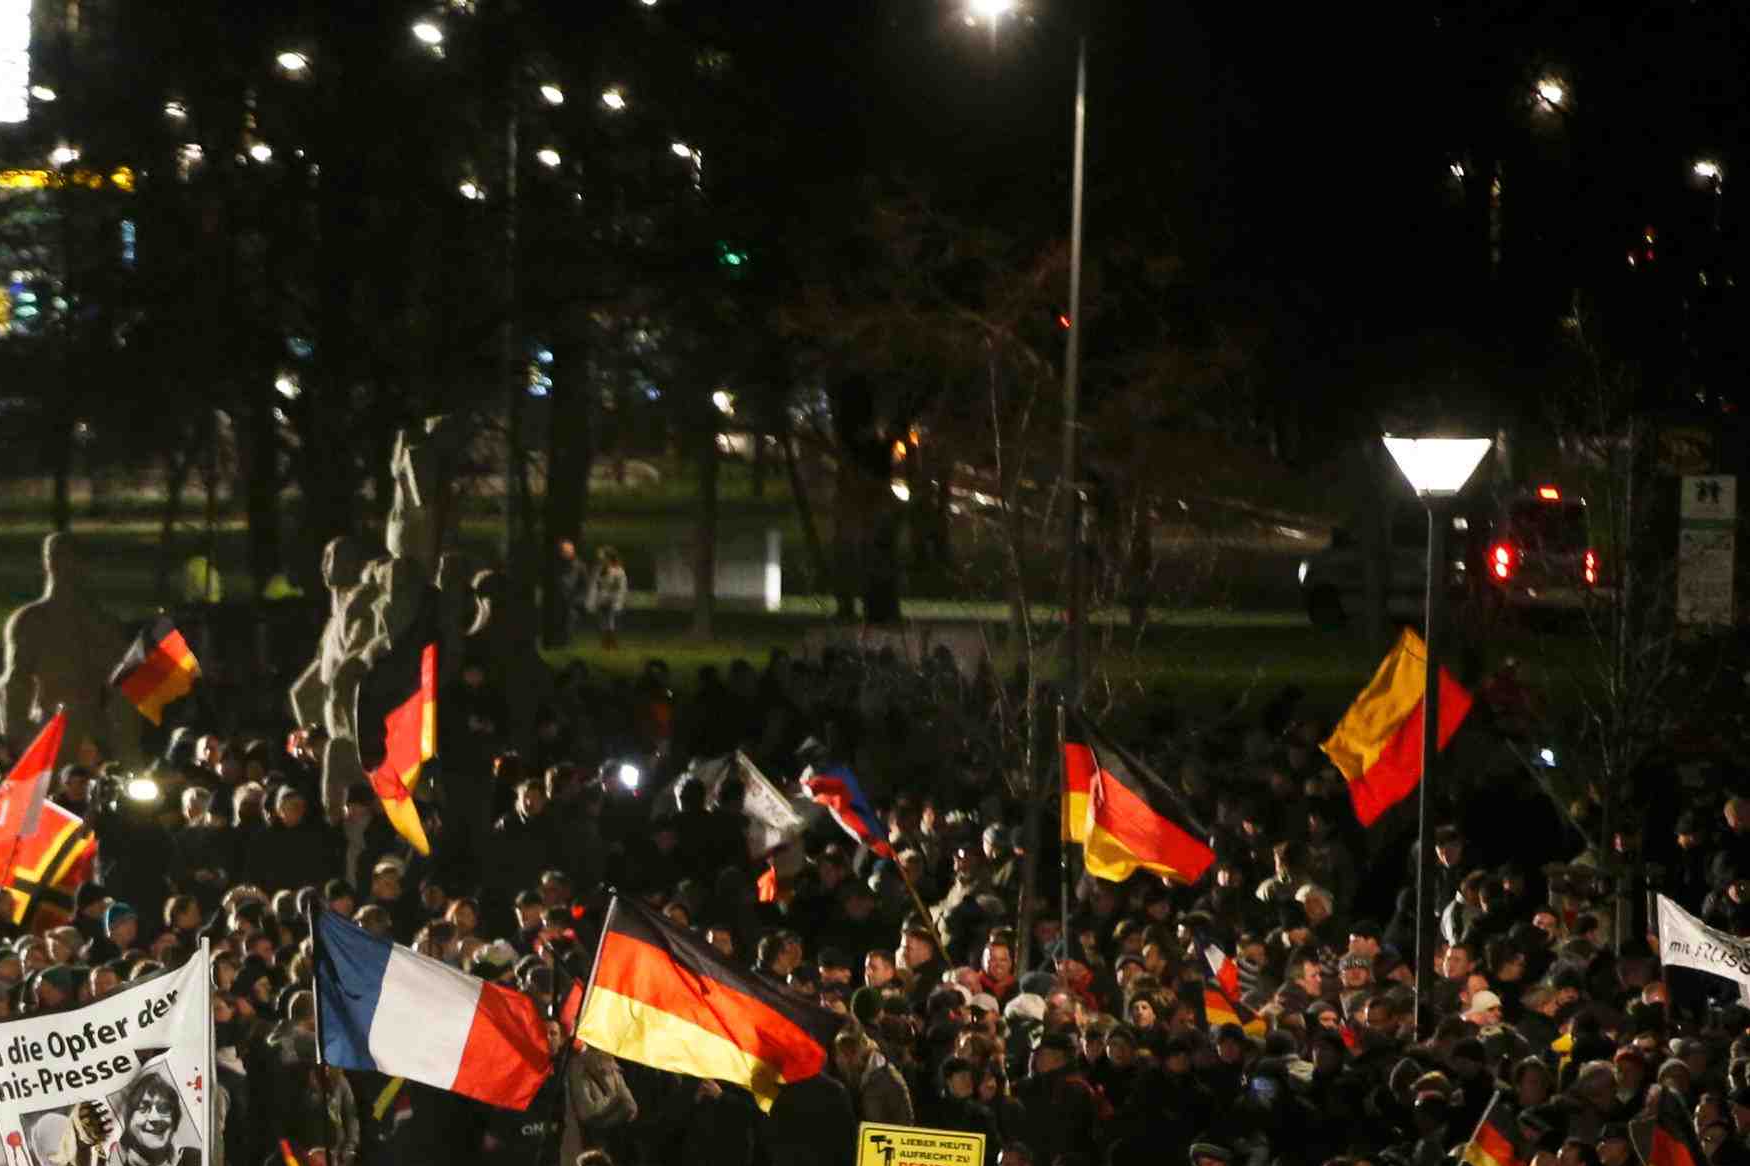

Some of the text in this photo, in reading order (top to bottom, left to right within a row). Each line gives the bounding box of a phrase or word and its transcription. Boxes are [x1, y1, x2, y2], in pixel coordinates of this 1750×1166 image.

[8, 1033, 44, 1065] die
[47, 1015, 130, 1061] Opfer
[137, 988, 179, 1028] der
[900, 1137, 973, 1151] LIEBER HEUTE
[899, 1149, 954, 1161] AUFRECHT
